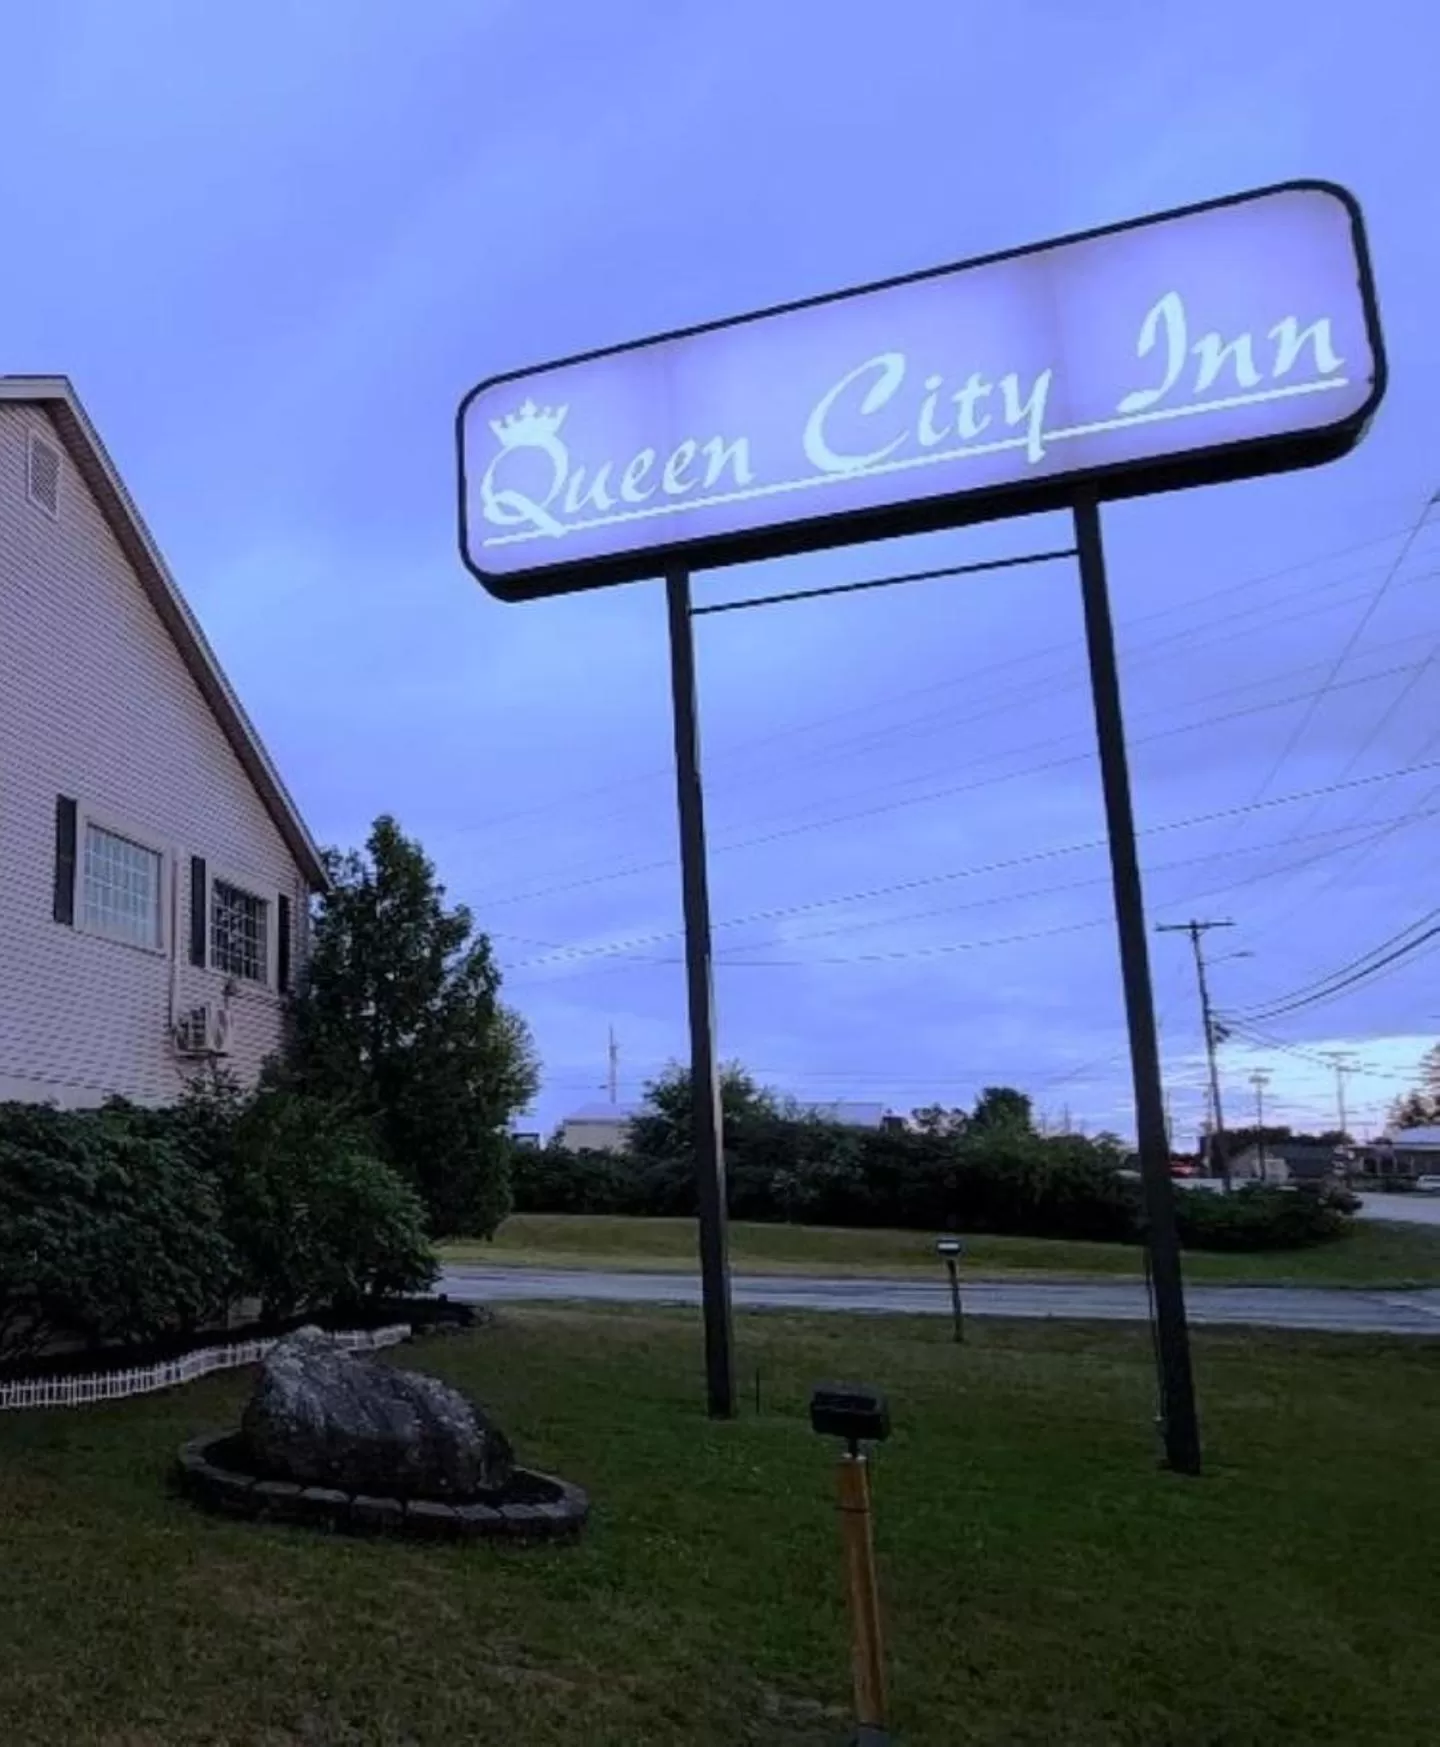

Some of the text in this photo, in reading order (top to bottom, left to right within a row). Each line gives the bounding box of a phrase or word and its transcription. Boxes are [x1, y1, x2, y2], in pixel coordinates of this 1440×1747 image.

[480, 291, 1346, 538] Queen City Inn
